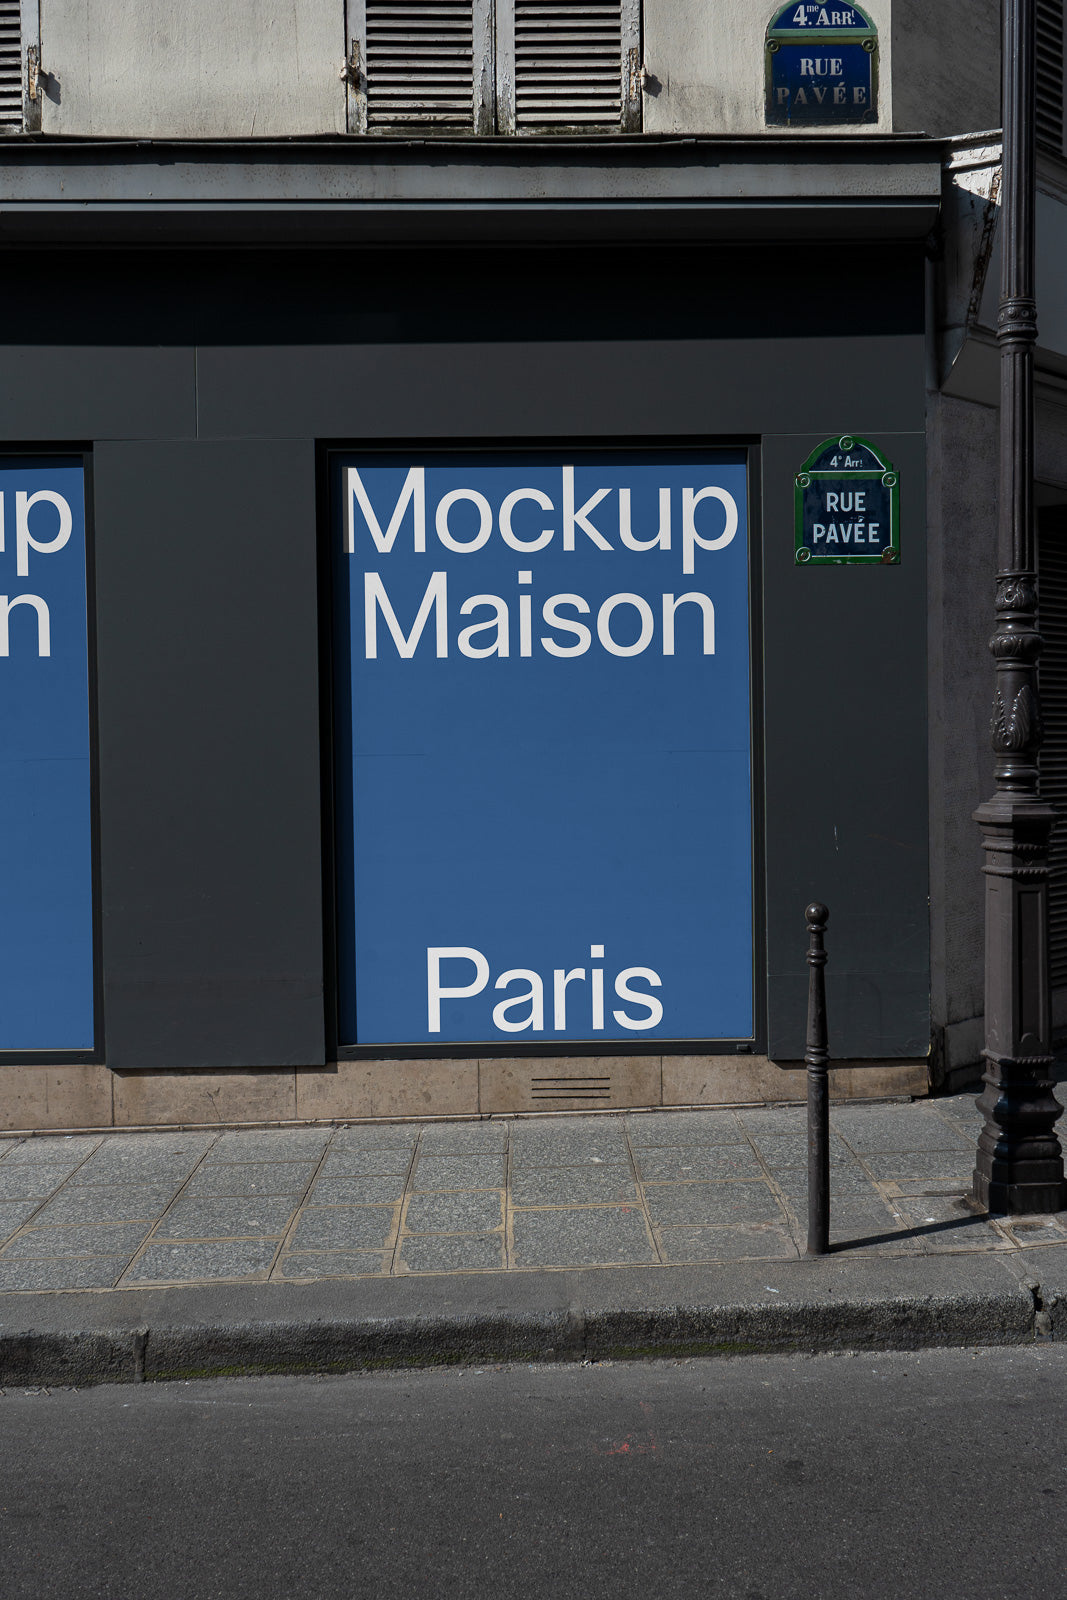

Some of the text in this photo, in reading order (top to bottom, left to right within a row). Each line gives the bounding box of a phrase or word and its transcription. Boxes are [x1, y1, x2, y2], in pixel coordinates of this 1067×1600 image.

[799, 58, 843, 76] RUE
[776, 81, 867, 105] PAVÉE
[826, 491, 866, 512] RUE
[342, 464, 738, 575] Mockup
[812, 517, 880, 543] PAVÉE
[364, 570, 715, 659] Maison
[427, 944, 664, 1033] Paris
